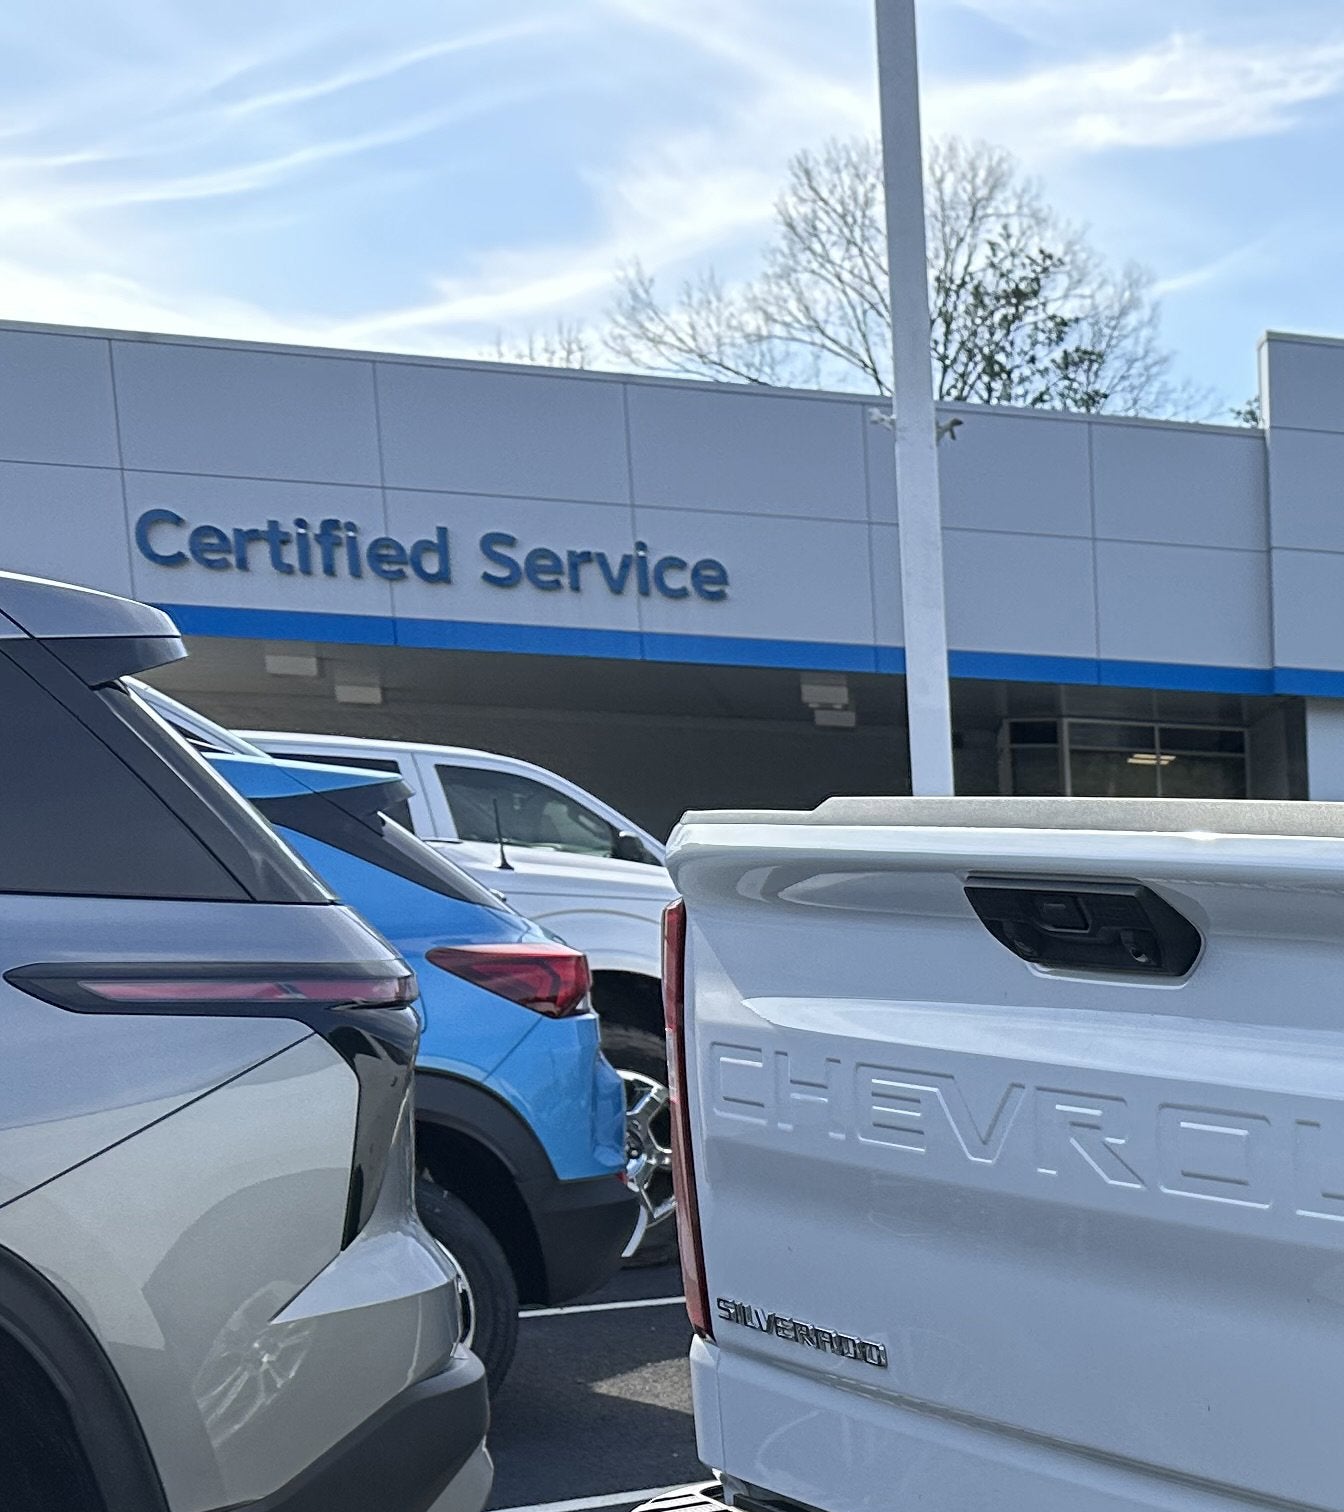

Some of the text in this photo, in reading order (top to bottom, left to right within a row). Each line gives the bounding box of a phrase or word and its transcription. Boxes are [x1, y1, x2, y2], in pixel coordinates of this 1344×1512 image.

[134, 508, 729, 601] Certified Service
[717, 1298, 888, 1368] SILVERADO
